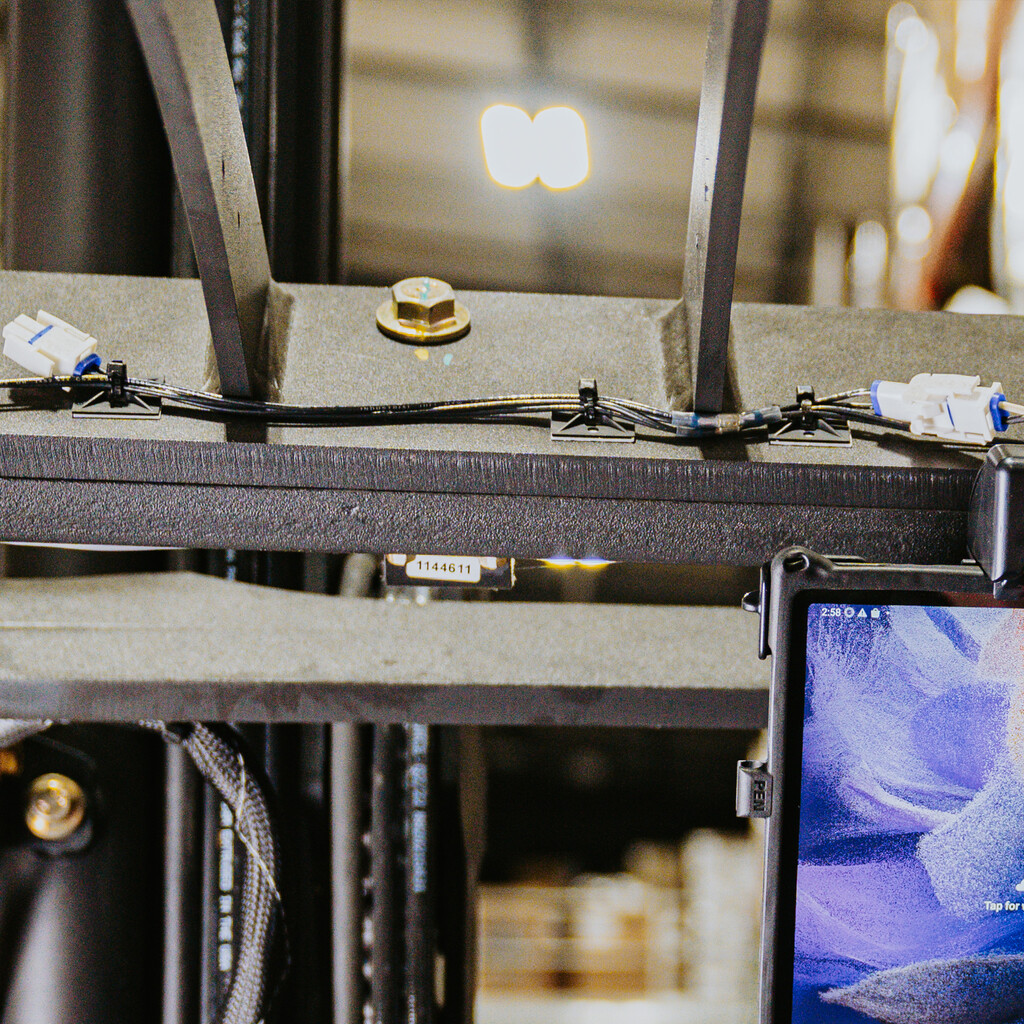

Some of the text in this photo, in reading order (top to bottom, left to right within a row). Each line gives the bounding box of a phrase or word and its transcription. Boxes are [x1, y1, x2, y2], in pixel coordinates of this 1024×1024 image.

[417, 560, 472, 575] 1144611
[821, 607, 842, 617] 2:58
[754, 780, 767, 811] PEN
[984, 900, 1003, 912] Tap
[1005, 900, 1019, 911] for
